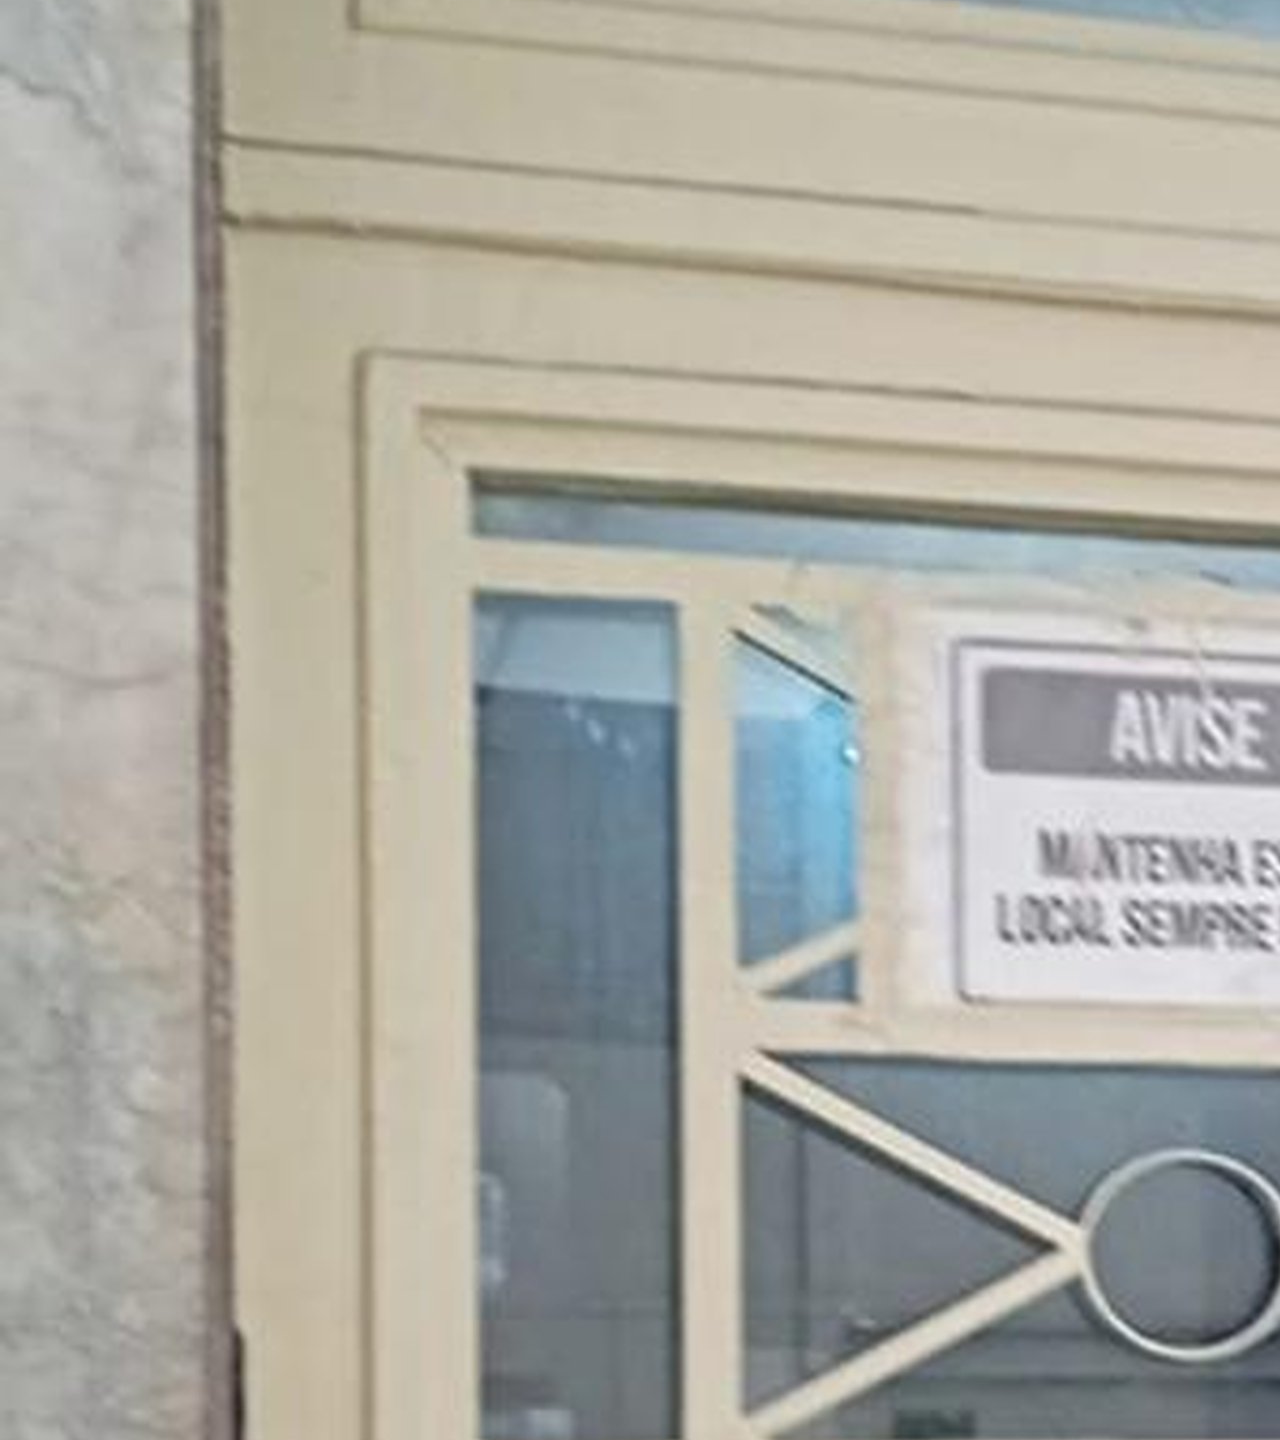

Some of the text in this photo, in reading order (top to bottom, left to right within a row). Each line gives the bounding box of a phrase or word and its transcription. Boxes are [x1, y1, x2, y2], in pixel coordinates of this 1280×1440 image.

[1110, 689, 1269, 771] AVISE
[996, 893, 1112, 946] LOCAL
[1121, 899, 1274, 952] SEMPRE
